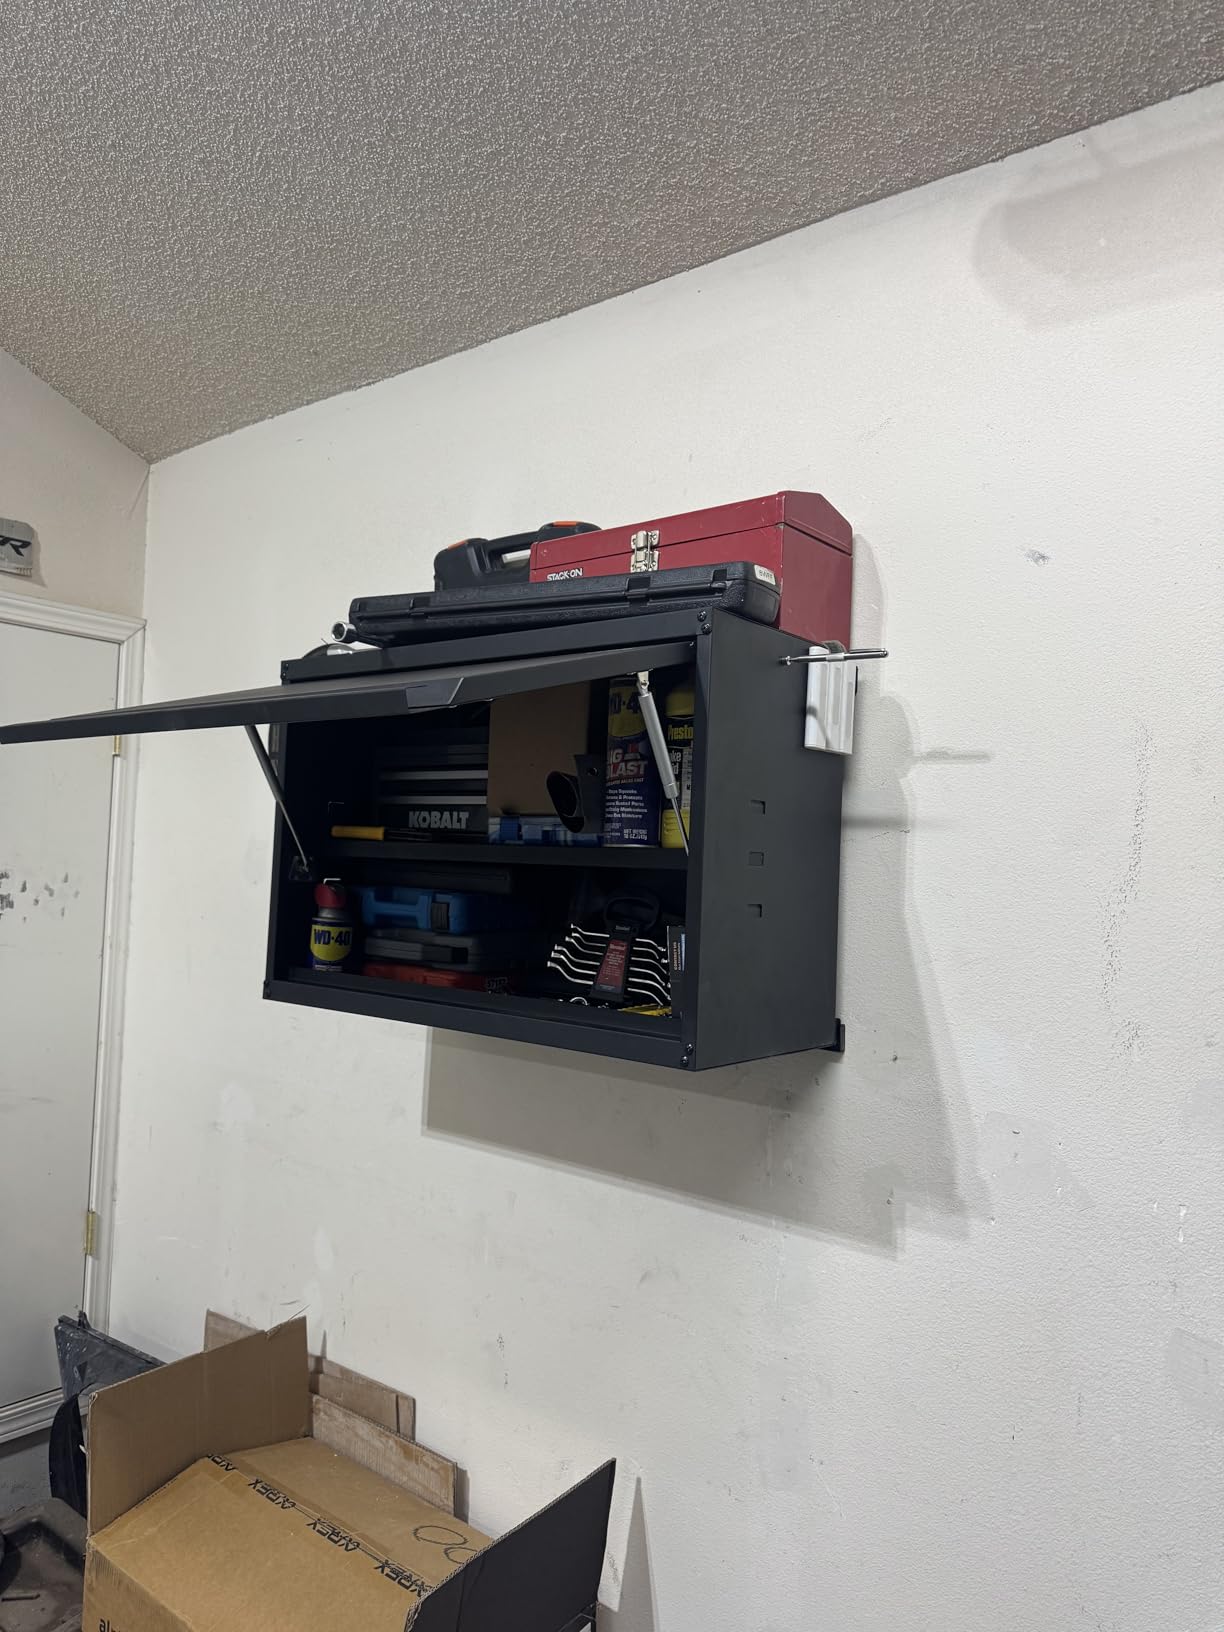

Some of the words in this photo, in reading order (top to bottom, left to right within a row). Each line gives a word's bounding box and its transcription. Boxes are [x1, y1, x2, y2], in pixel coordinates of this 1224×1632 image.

[668, 724, 694, 741] Presto
[606, 759, 648, 779] LAST
[408, 811, 470, 829] KOBALT
[314, 929, 352, 945] WD-40
